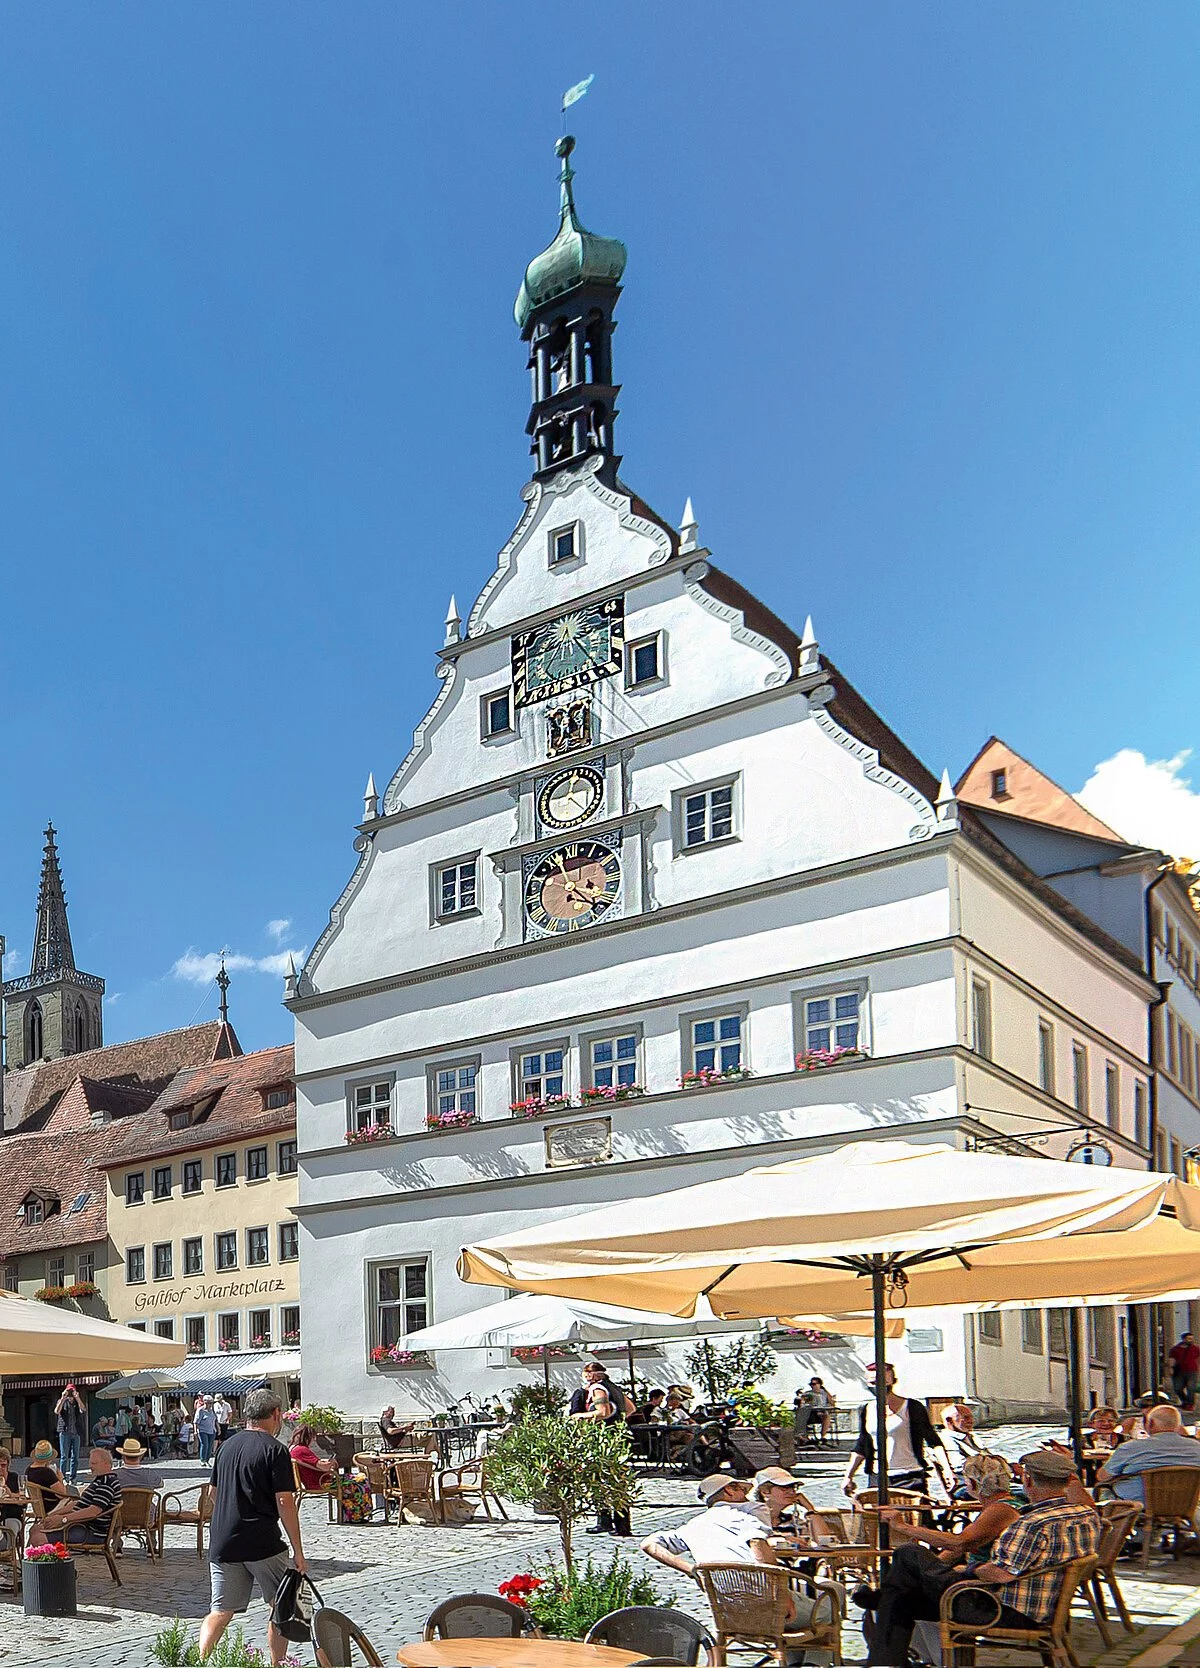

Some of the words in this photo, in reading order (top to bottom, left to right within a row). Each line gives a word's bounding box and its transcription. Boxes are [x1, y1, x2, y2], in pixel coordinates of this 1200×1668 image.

[518, 633, 531, 647] 17
[565, 844, 578, 859] XII
[194, 1278, 286, 1300] Marktplatz
